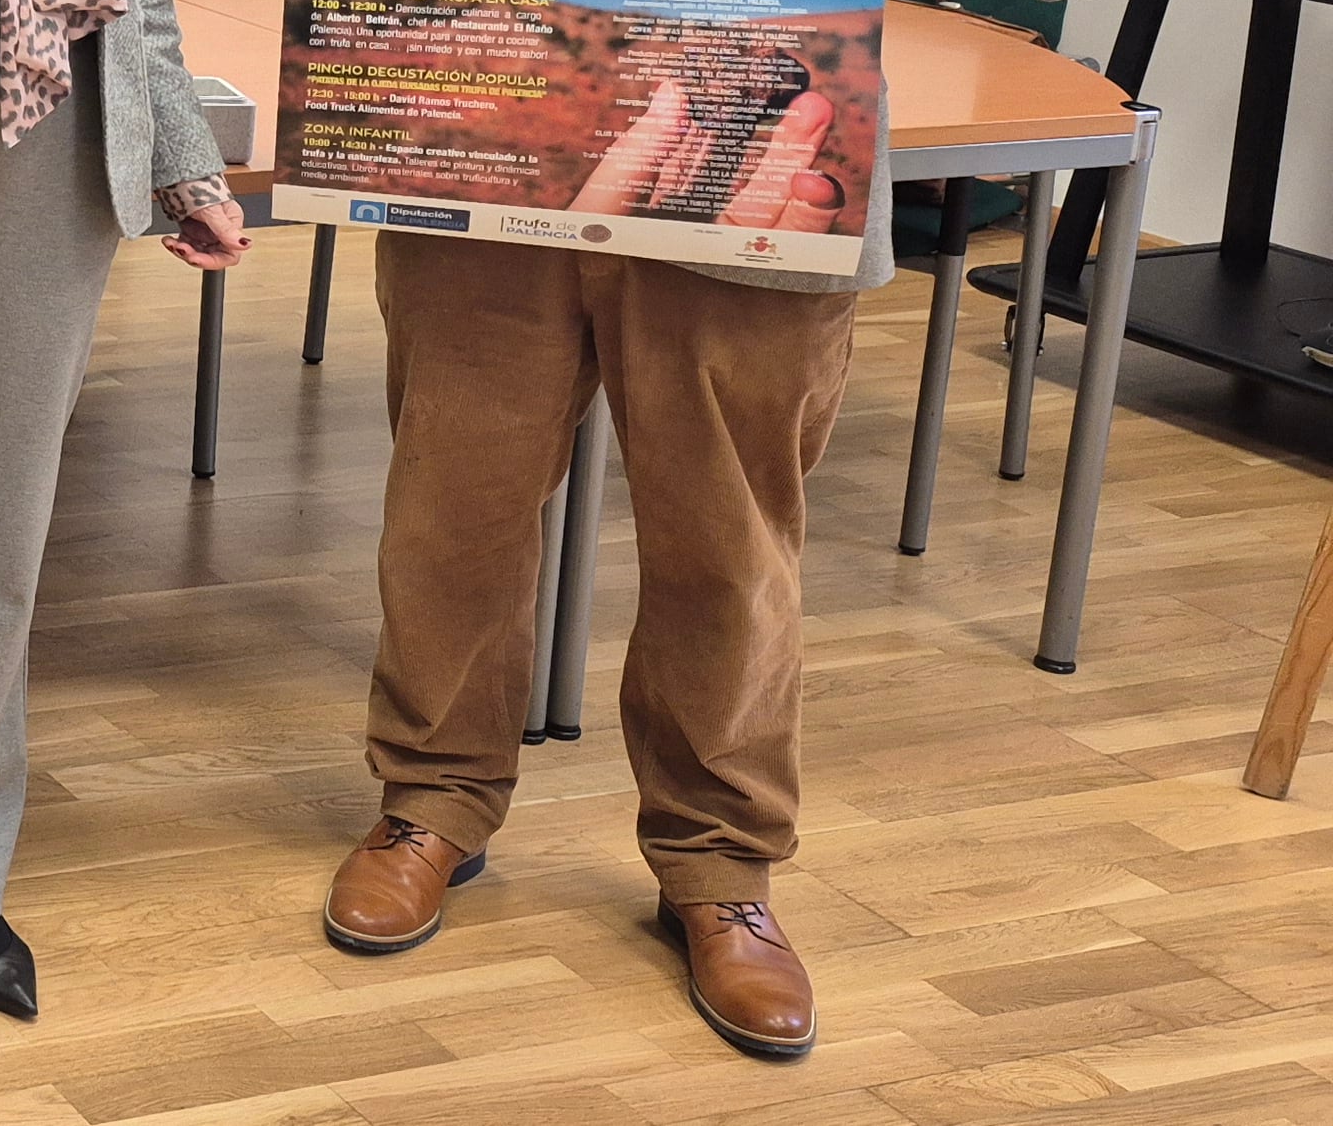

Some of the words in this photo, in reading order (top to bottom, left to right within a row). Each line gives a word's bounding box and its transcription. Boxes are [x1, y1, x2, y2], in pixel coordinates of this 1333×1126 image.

[308, 62, 363, 75] PINCHO
[368, 66, 471, 82] DEGUSTACIÓN
[476, 73, 547, 88] POPULAR
[305, 100, 328, 111] Food
[330, 102, 356, 113] Truck
[357, 104, 405, 116] Alimentos
[407, 107, 418, 117] de
[421, 108, 464, 120] Palencia.
[303, 123, 345, 136] ZONA
[349, 126, 414, 141] INFANTIL
[390, 206, 452, 220] Diputación
[508, 216, 550, 229] Trufa
[555, 220, 577, 231] de
[507, 227, 577, 241] PALENCIA
